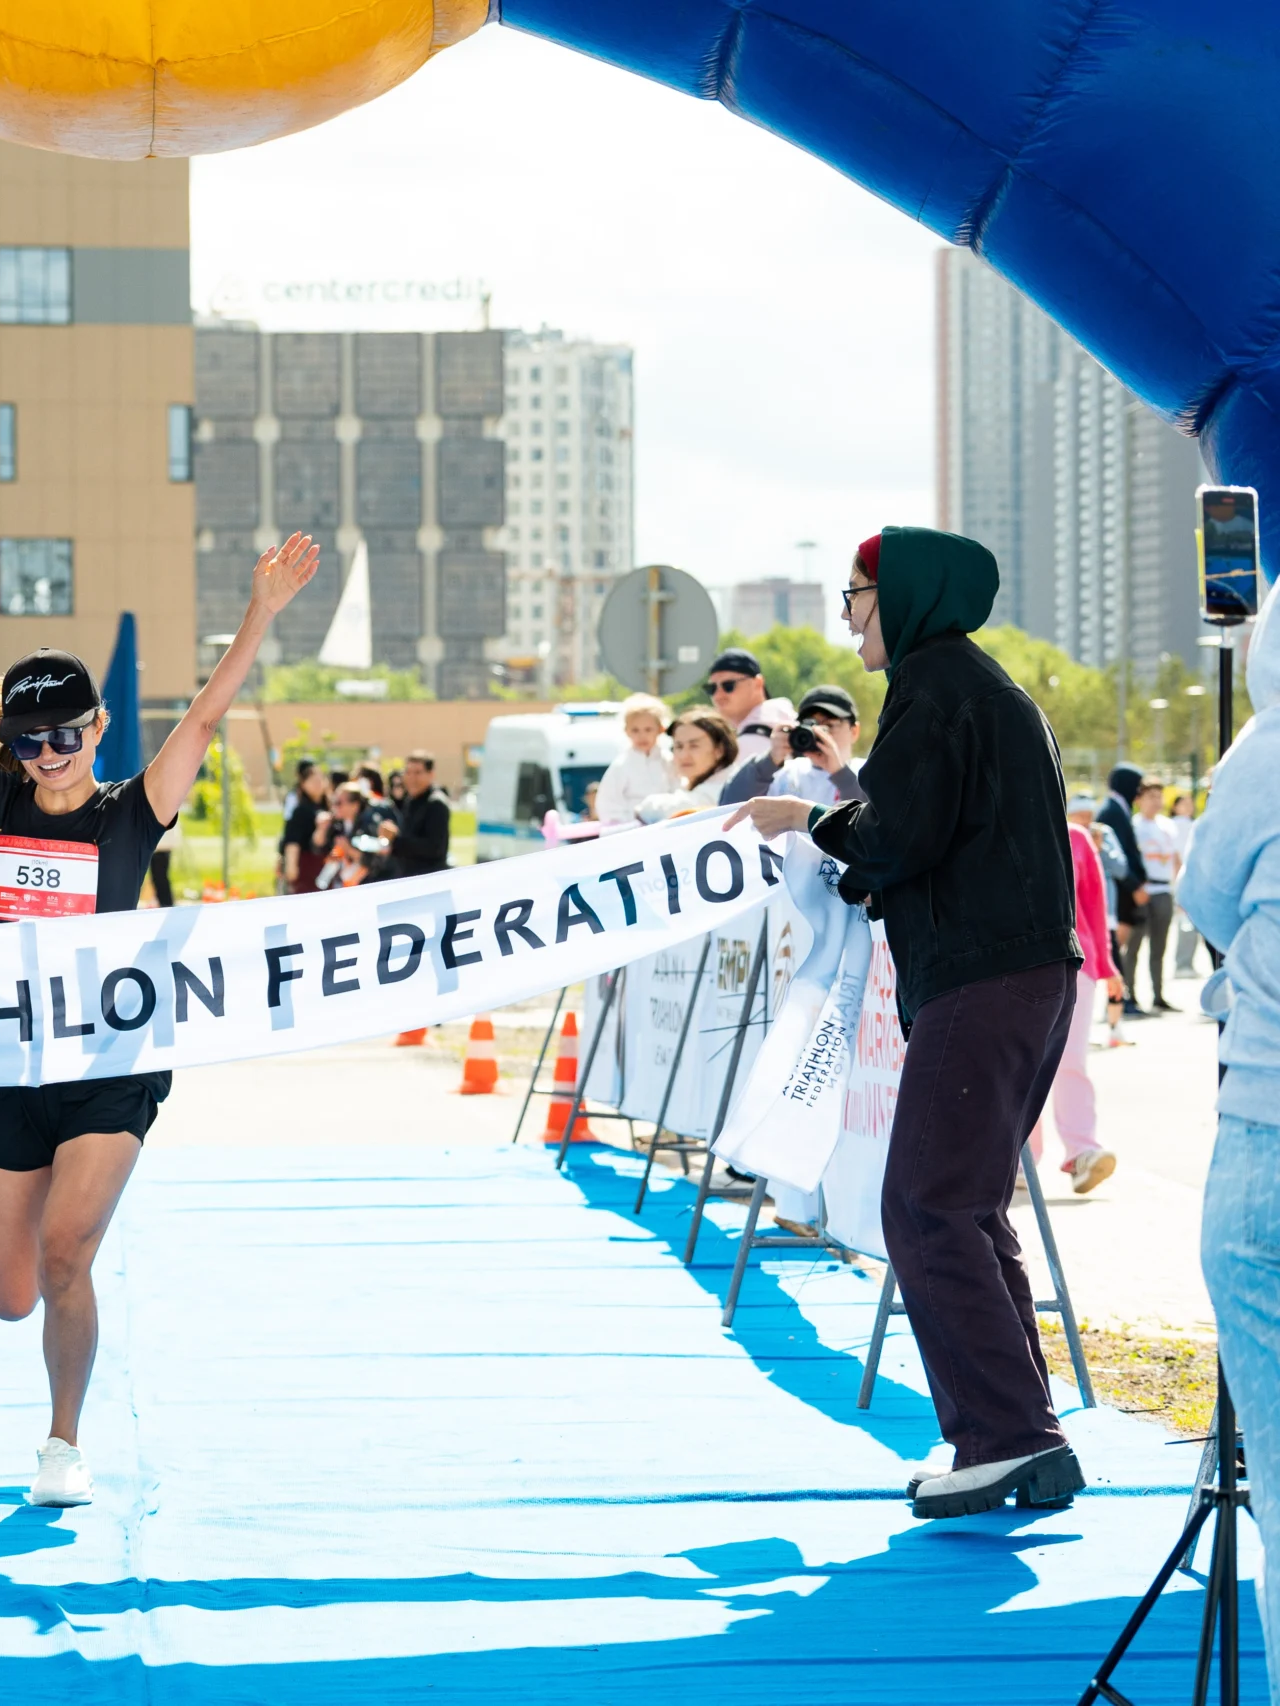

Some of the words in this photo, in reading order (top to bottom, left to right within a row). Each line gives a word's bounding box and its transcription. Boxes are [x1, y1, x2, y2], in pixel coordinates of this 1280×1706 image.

[16, 865, 61, 889] 538
[791, 1020, 836, 1101] TRIATHLON
[806, 1027, 847, 1107] FEDERATION
